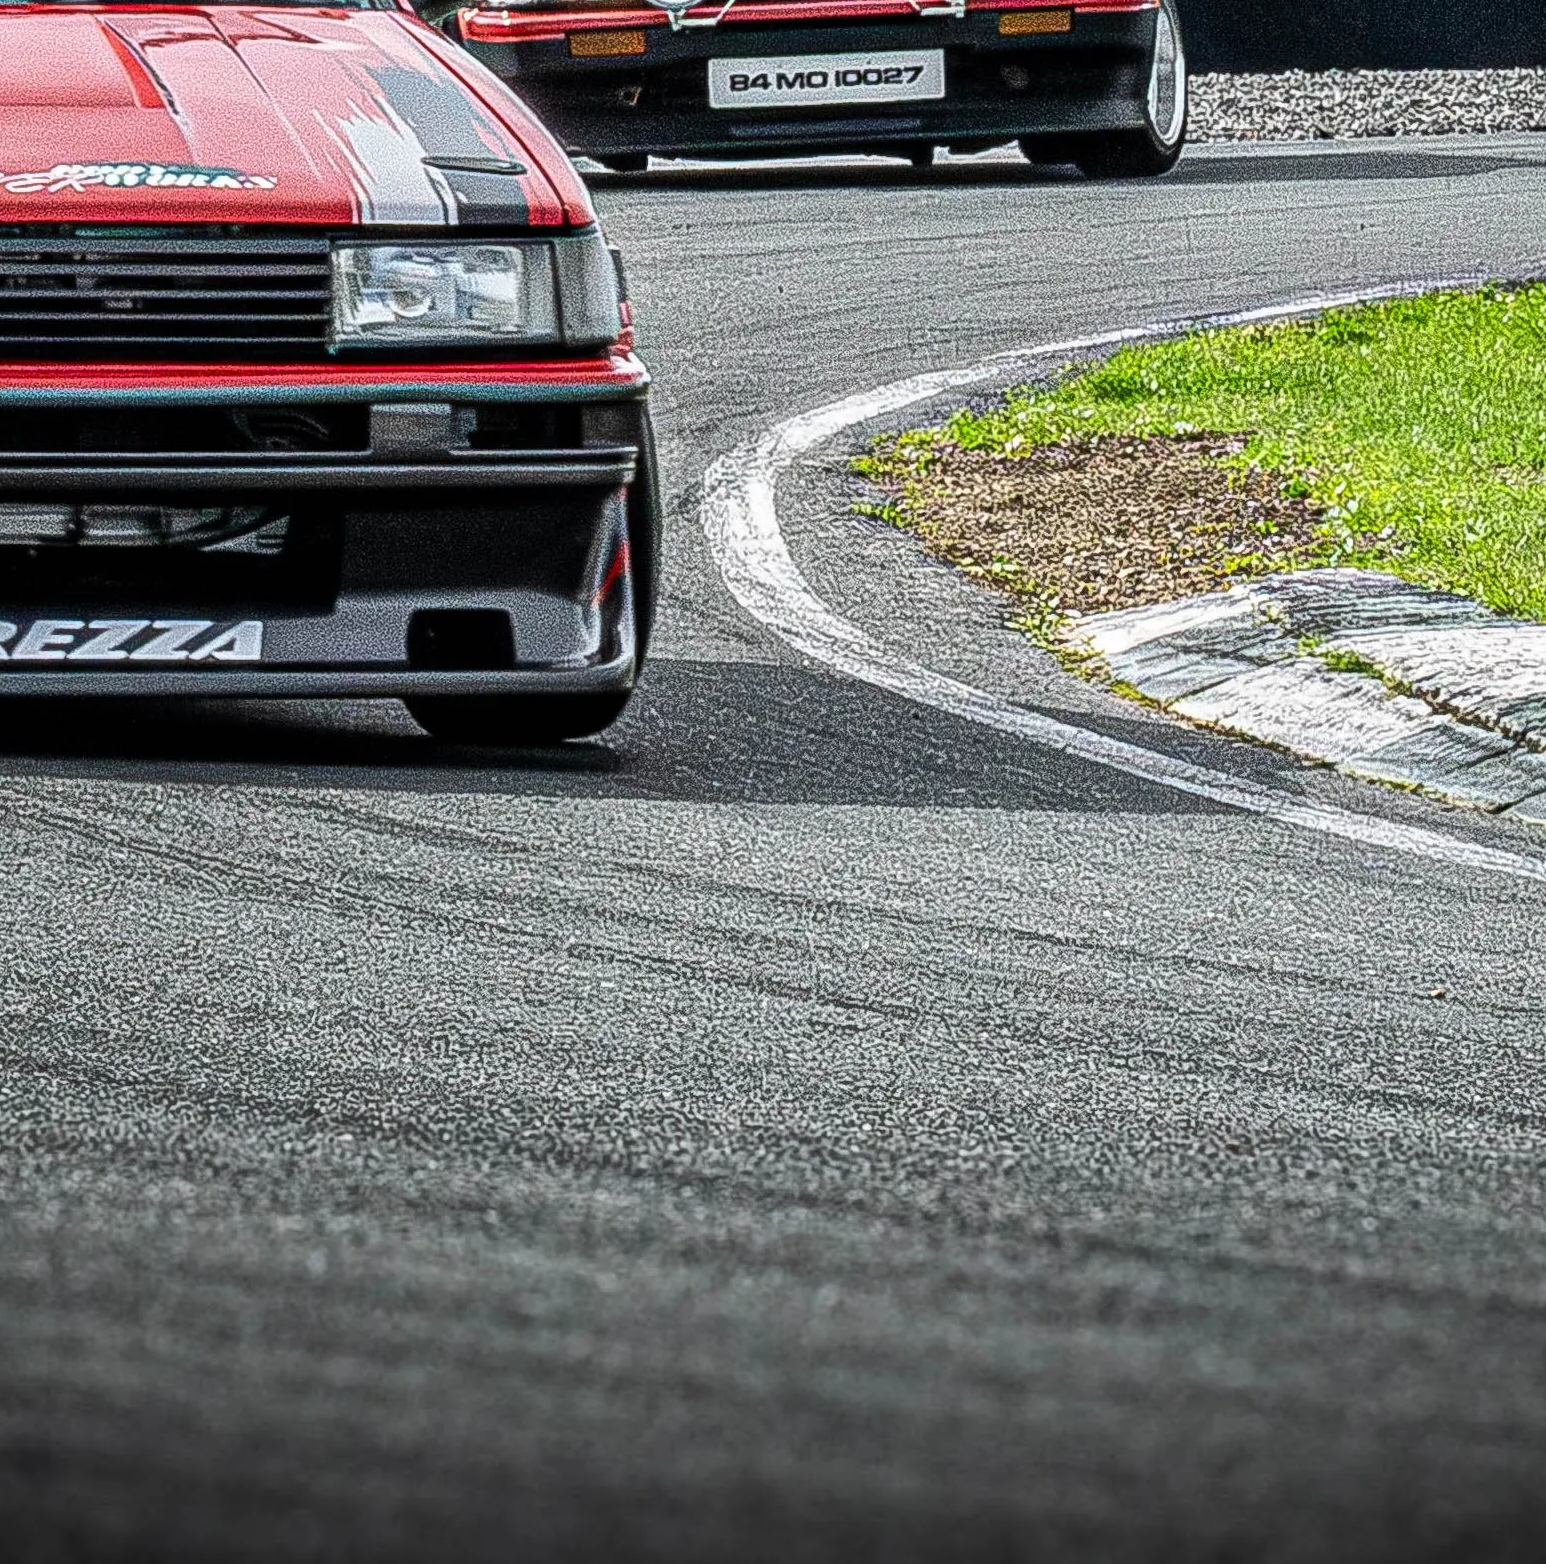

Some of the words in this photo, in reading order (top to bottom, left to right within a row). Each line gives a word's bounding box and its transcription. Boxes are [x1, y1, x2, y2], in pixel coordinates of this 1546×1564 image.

[728, 73, 773, 93] 84
[775, 70, 829, 90] MO
[834, 65, 925, 88] 10027
